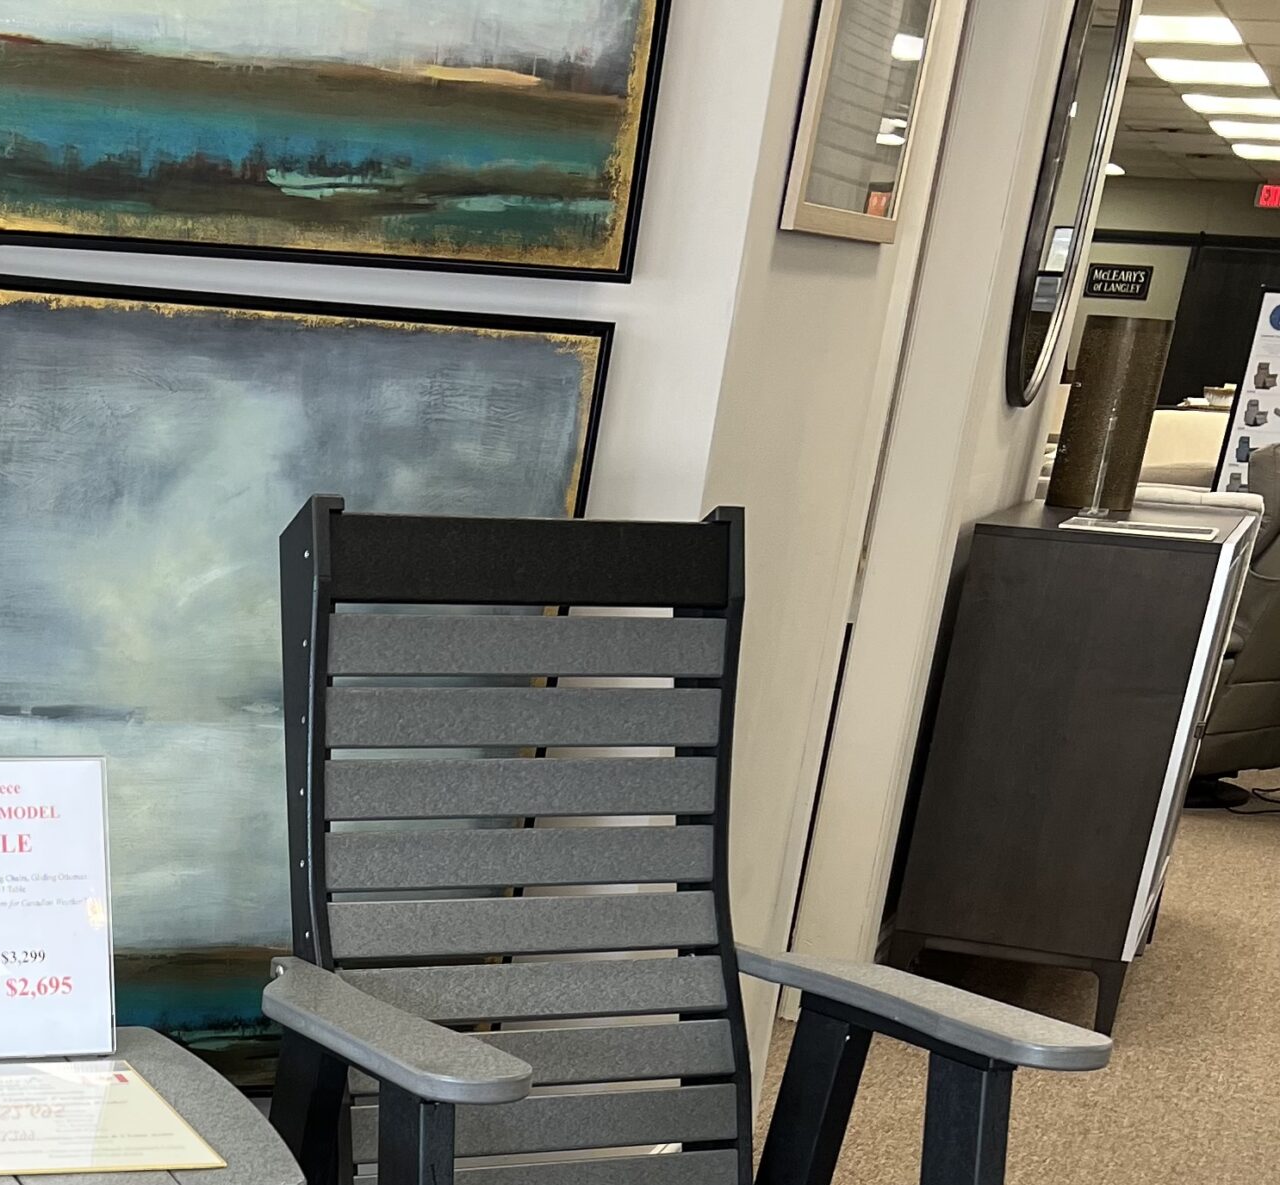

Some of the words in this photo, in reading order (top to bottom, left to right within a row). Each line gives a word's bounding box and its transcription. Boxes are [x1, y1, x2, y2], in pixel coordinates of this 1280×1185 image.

[1093, 282, 1103, 292] of
[1103, 283, 1142, 294] LANGLEY
[1, 949, 46, 966] $3,299
[5, 975, 73, 999] $2,695
